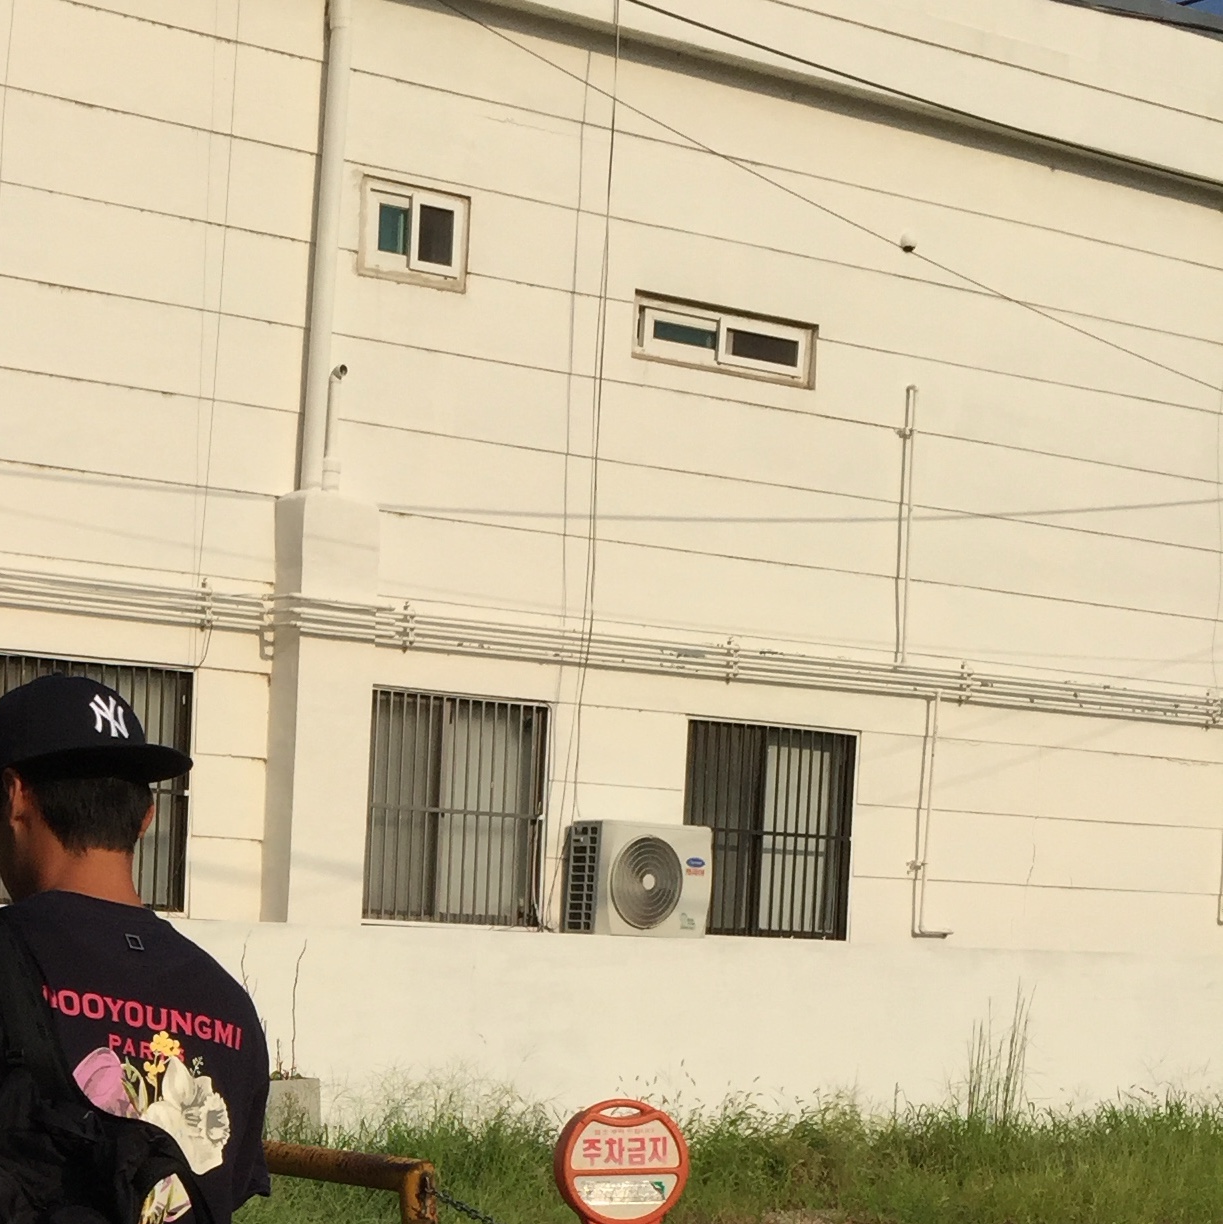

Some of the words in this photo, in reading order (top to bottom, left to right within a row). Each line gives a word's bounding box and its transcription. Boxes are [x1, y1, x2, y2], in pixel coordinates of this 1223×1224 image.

[89, 694, 130, 739] NY
[108, 1033, 185, 1063] PARS
[582, 1136, 668, 1166] 주차금지
